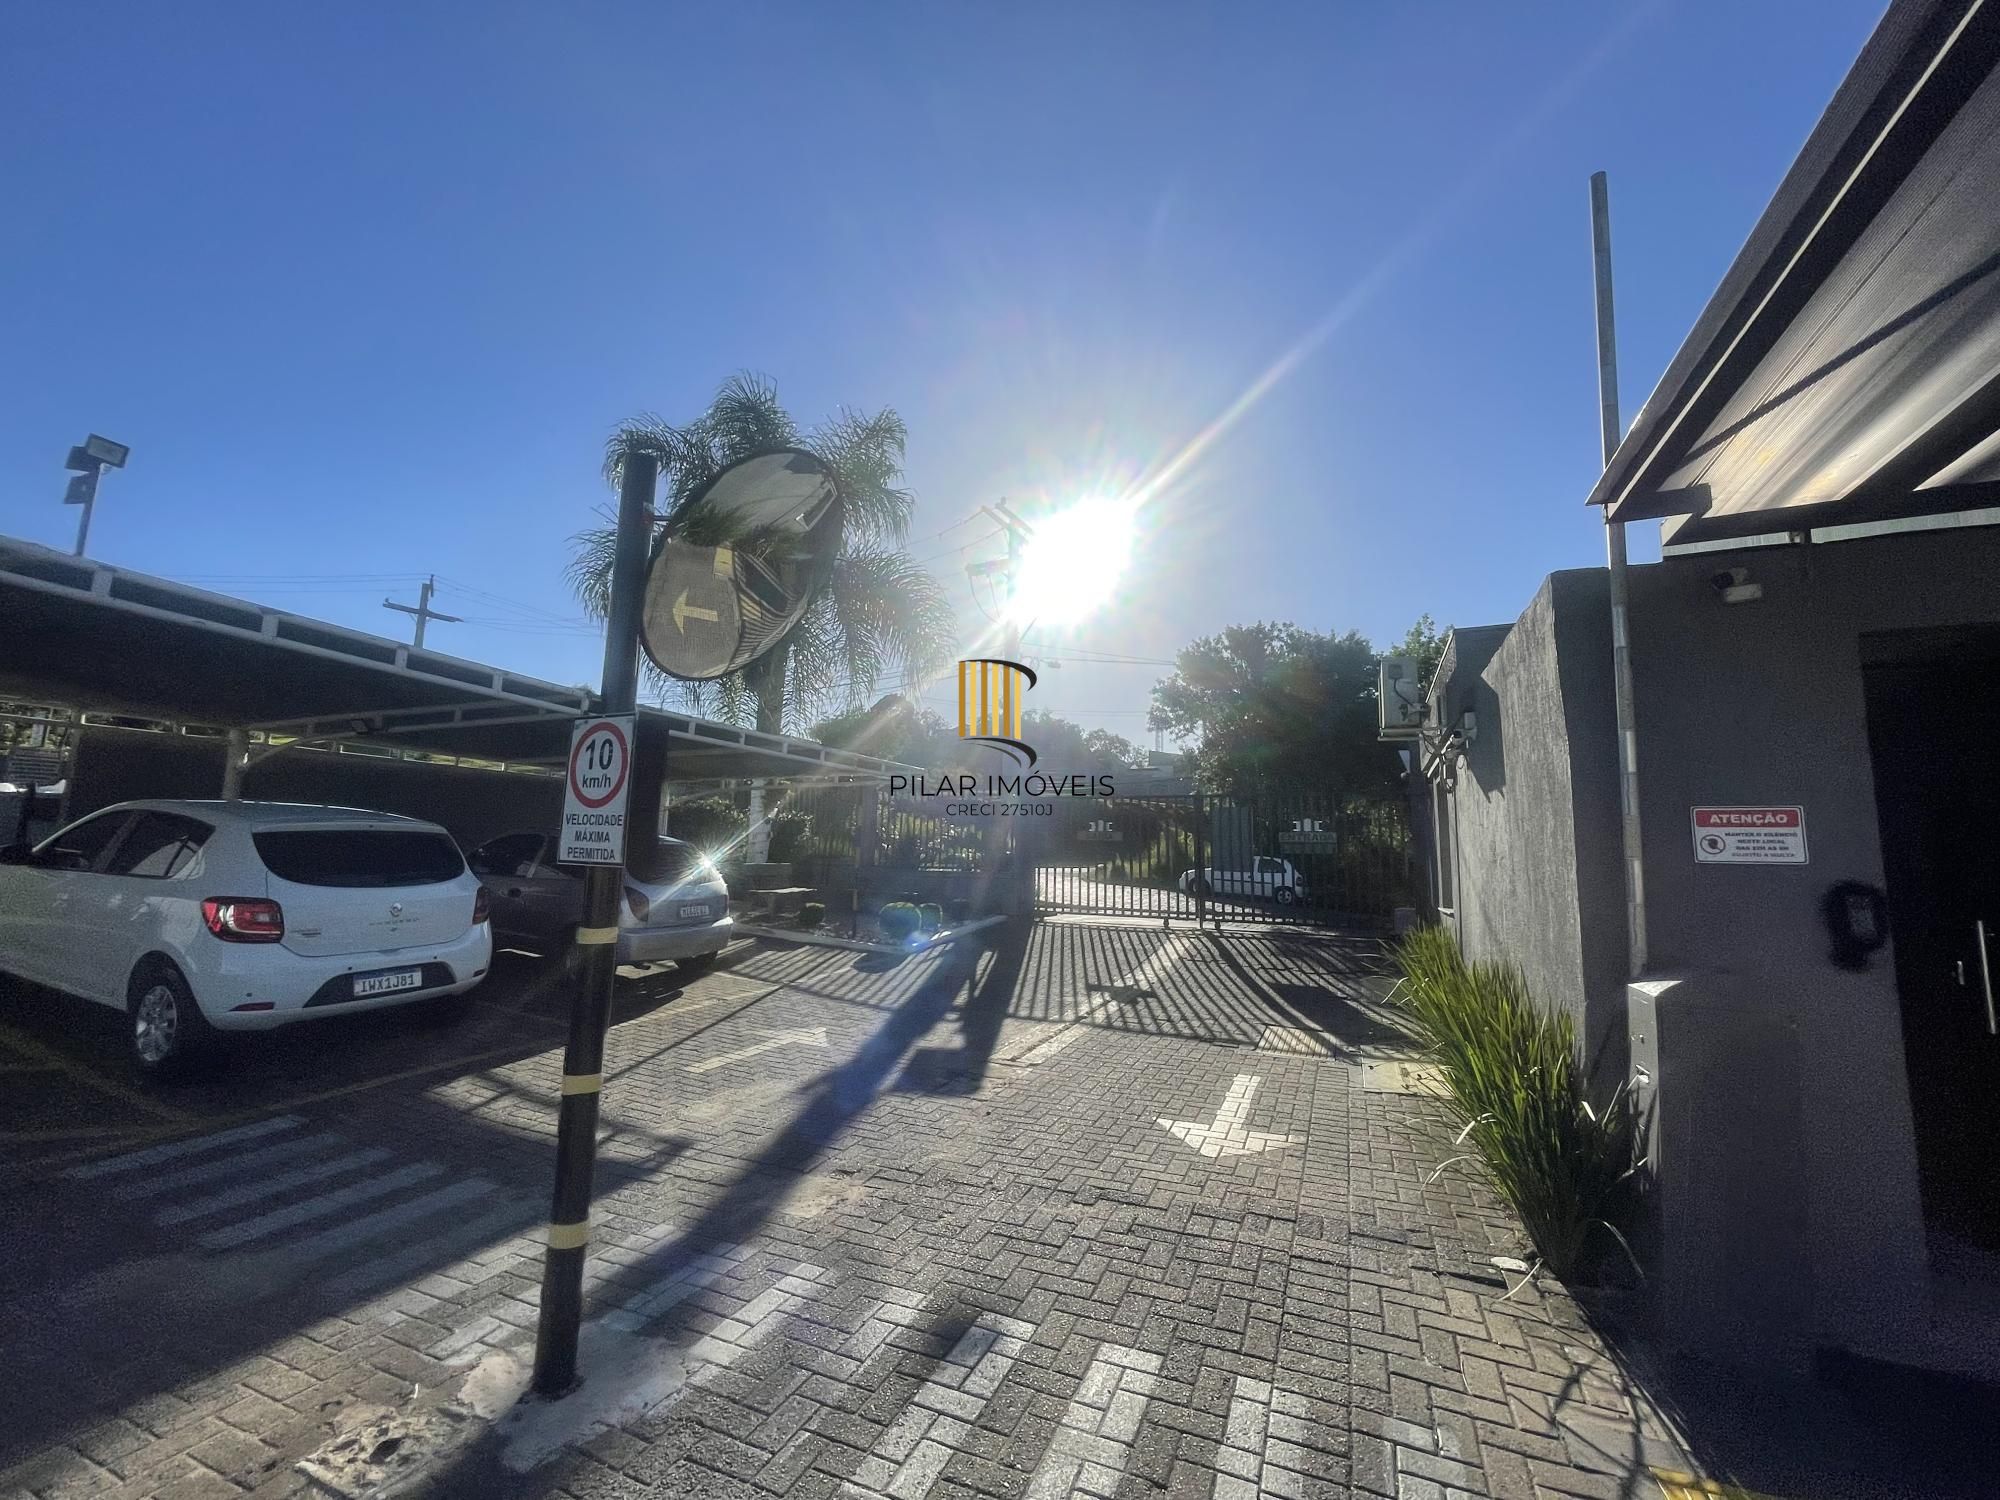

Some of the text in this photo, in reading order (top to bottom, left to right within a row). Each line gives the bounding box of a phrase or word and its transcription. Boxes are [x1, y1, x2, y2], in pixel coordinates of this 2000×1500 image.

[585, 738, 613, 770] 10
[582, 774, 611, 789] km/h
[566, 813, 623, 826] VELOCIDADE
[1710, 813, 1788, 825] ATENÇÃO
[574, 828, 610, 843] MÁXIMA
[567, 847, 616, 861] PERMITIDA
